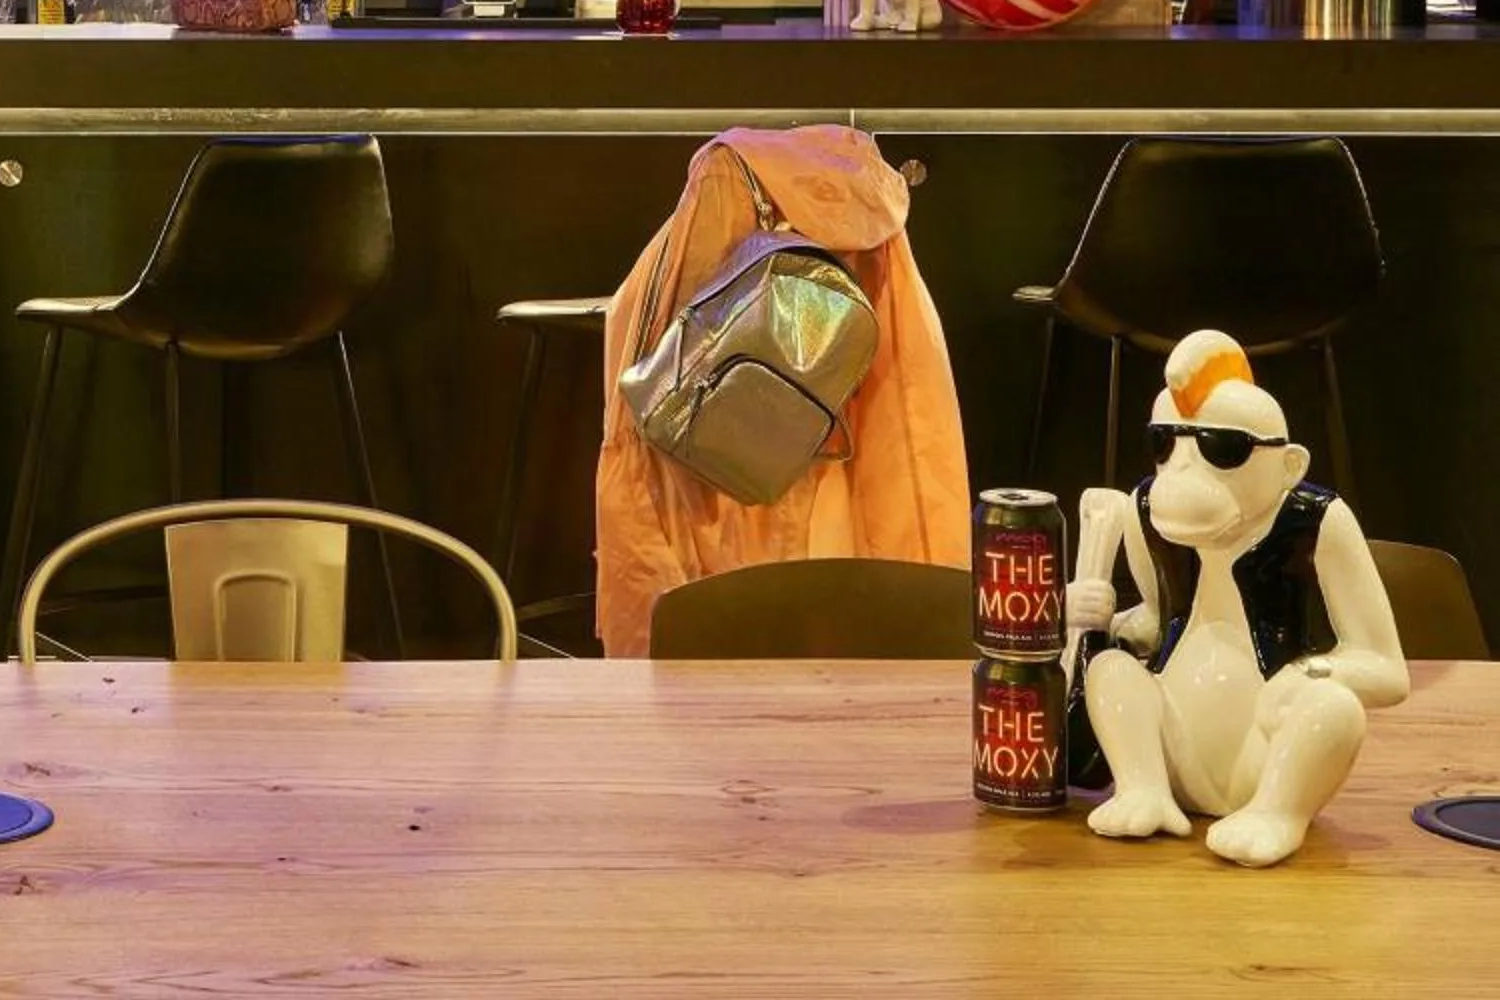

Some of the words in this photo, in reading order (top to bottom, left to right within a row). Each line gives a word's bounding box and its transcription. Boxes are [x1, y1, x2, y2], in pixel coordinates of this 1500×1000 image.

[985, 551, 1054, 586] THE
[978, 586, 1065, 622] MOXY
[978, 702, 1045, 742] THE
[973, 739, 1059, 779] MOXY
